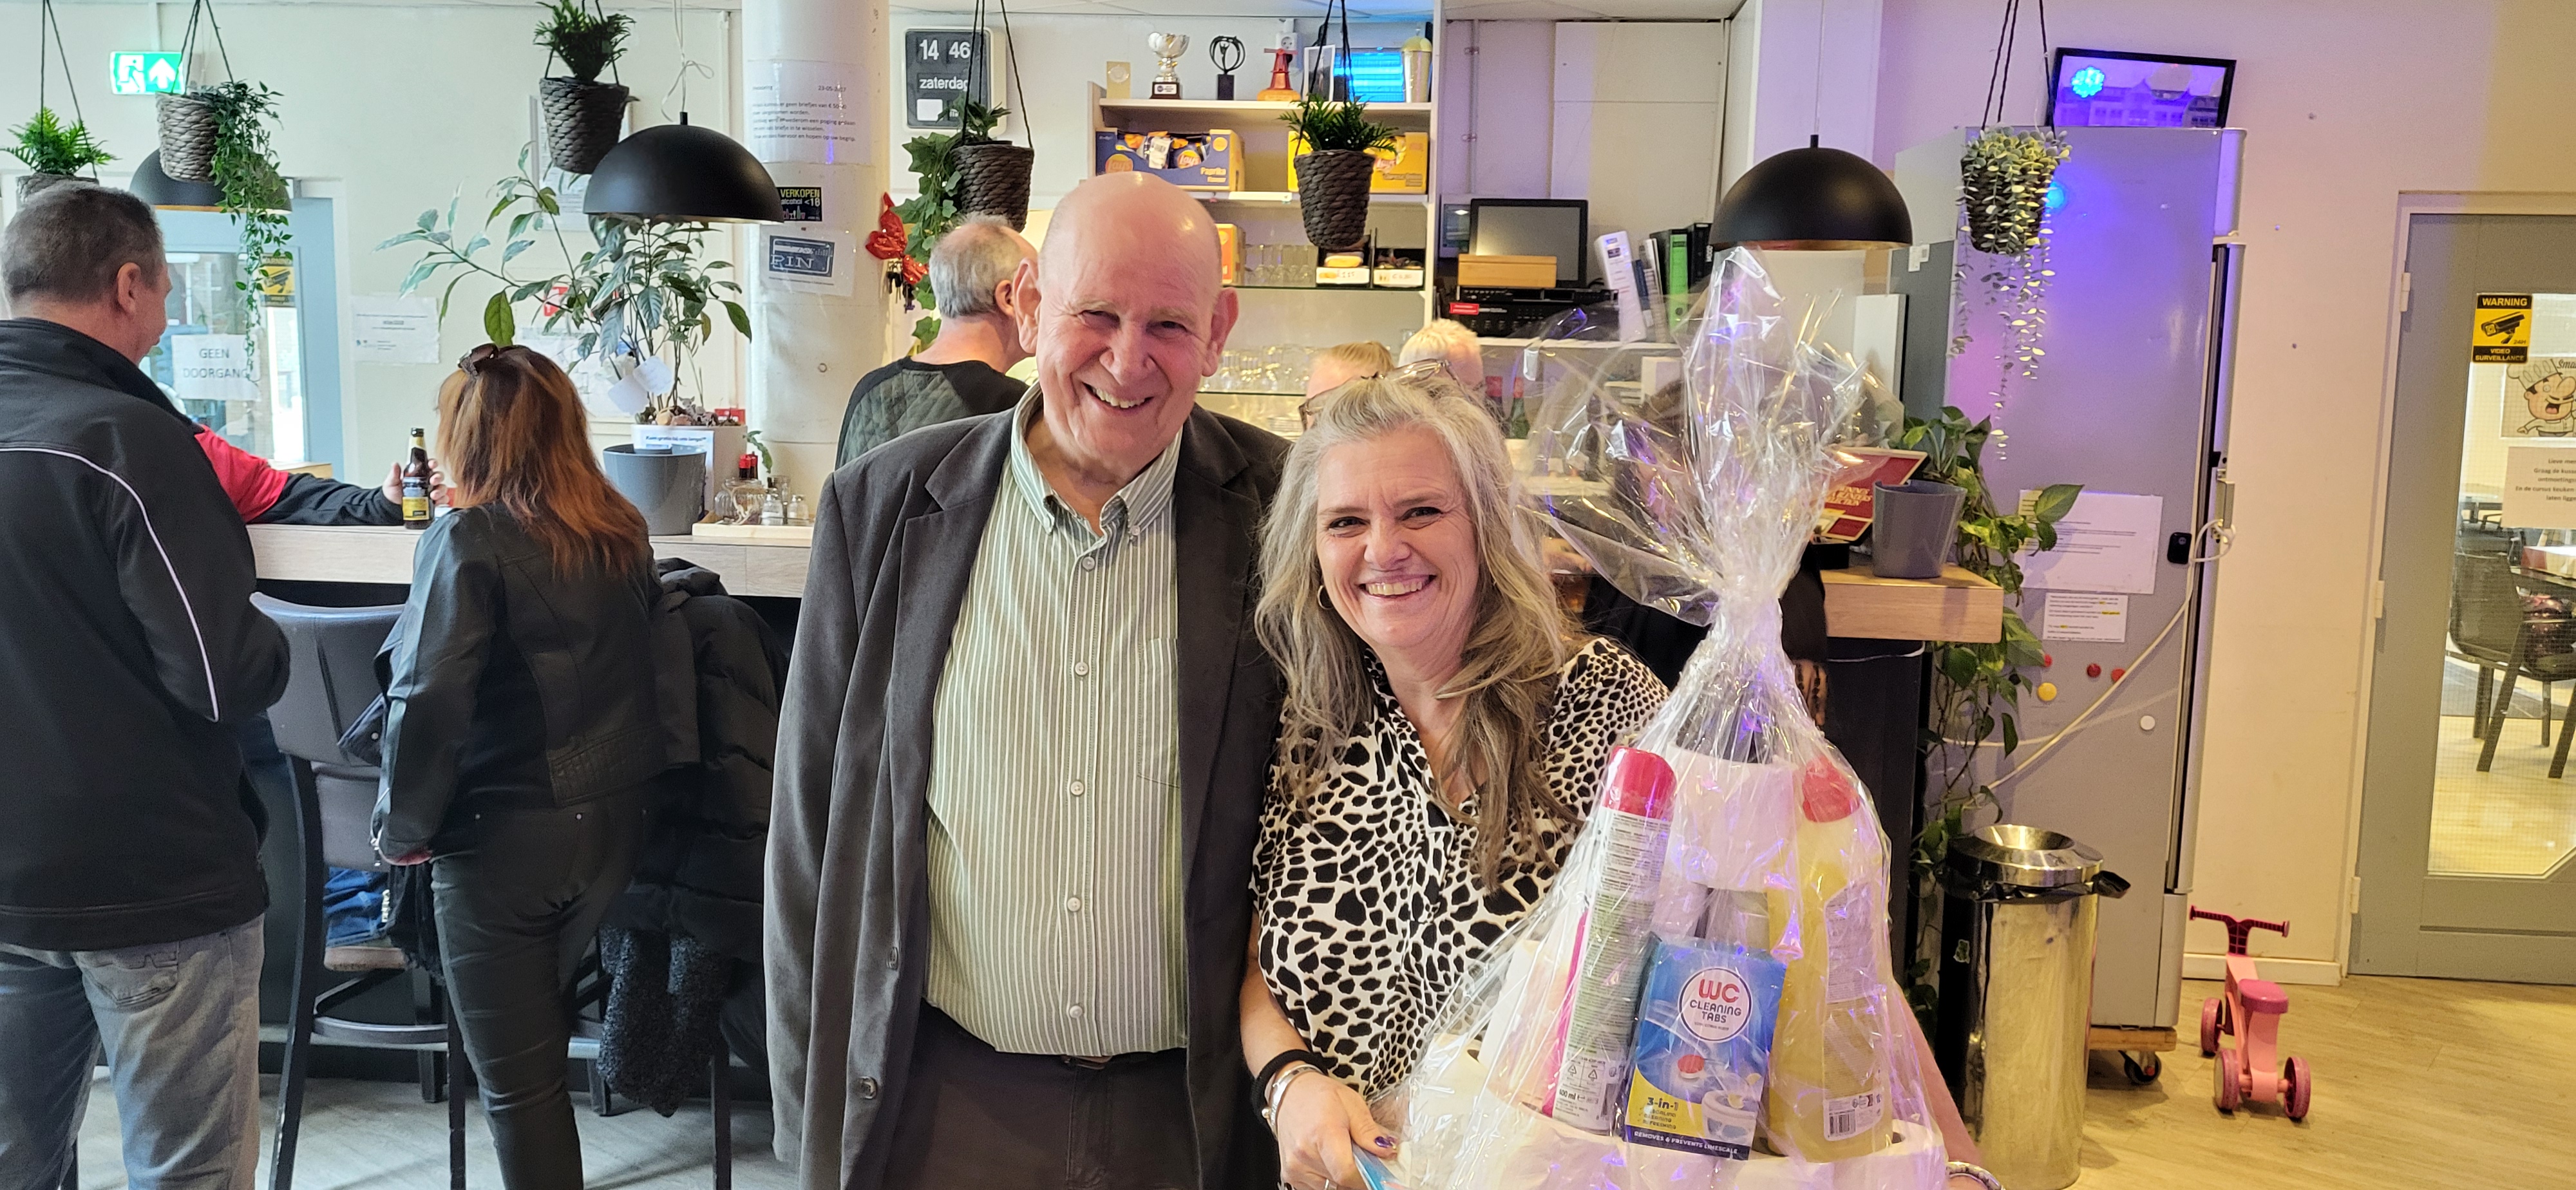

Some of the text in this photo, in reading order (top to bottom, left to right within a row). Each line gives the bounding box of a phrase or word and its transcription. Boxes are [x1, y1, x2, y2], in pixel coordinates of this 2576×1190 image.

[919, 39, 971, 60] 14 46
[780, 189, 820, 198] VERKOPEN
[770, 254, 814, 270] PIN
[2482, 298, 2528, 306] WARNING
[199, 348, 229, 359] GEEN
[1698, 979, 1740, 1003] WC
[1690, 999, 1741, 1016] CLEANING
[1701, 1011, 1727, 1023] TABS
[1647, 1097, 1678, 1111] 3-in-1
[1634, 1131, 1663, 1142] REMOVES
[1672, 1137, 1703, 1148] PREVENTS
[1704, 1142, 1738, 1154] LIMESCALE
